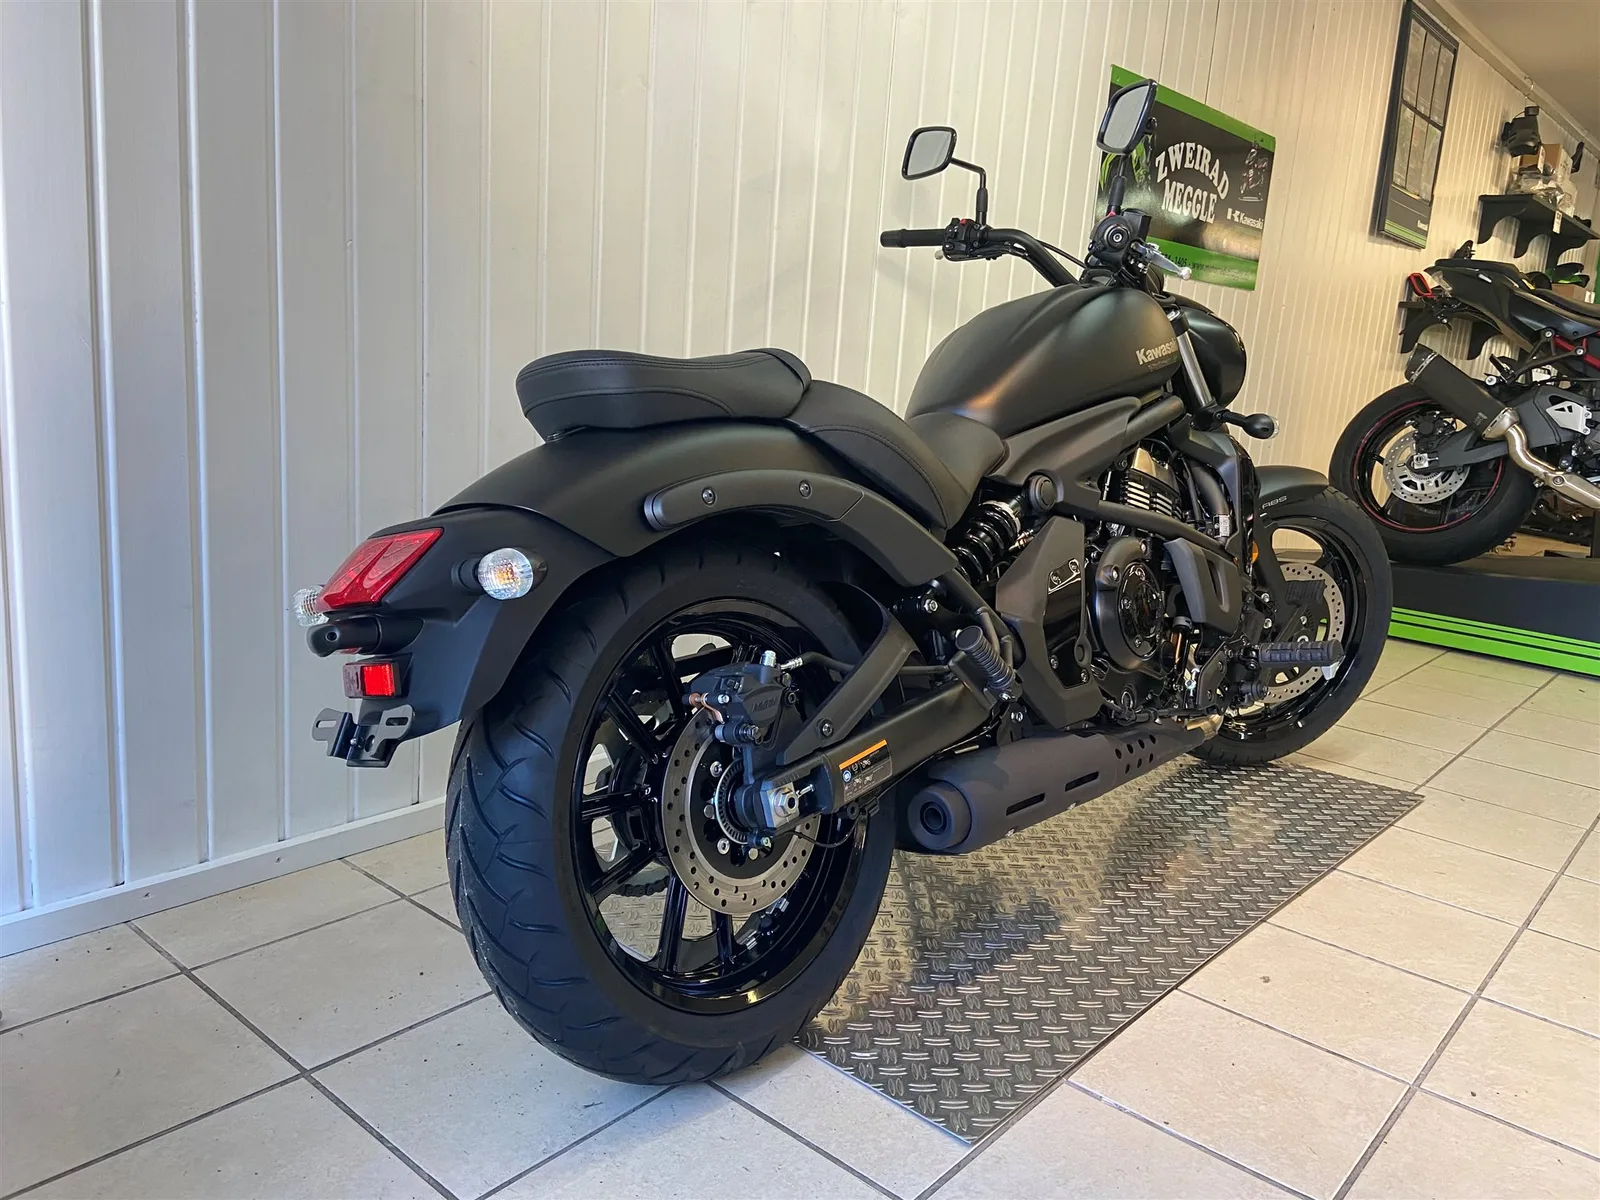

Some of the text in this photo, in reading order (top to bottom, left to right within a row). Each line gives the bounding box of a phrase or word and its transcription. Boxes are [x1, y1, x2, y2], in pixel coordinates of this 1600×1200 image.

[1155, 142, 1229, 200] ZWEIRAD
[1161, 178, 1218, 224] MEGGLE
[1135, 337, 1179, 365] Kawasak
[1261, 495, 1288, 510] ABS
